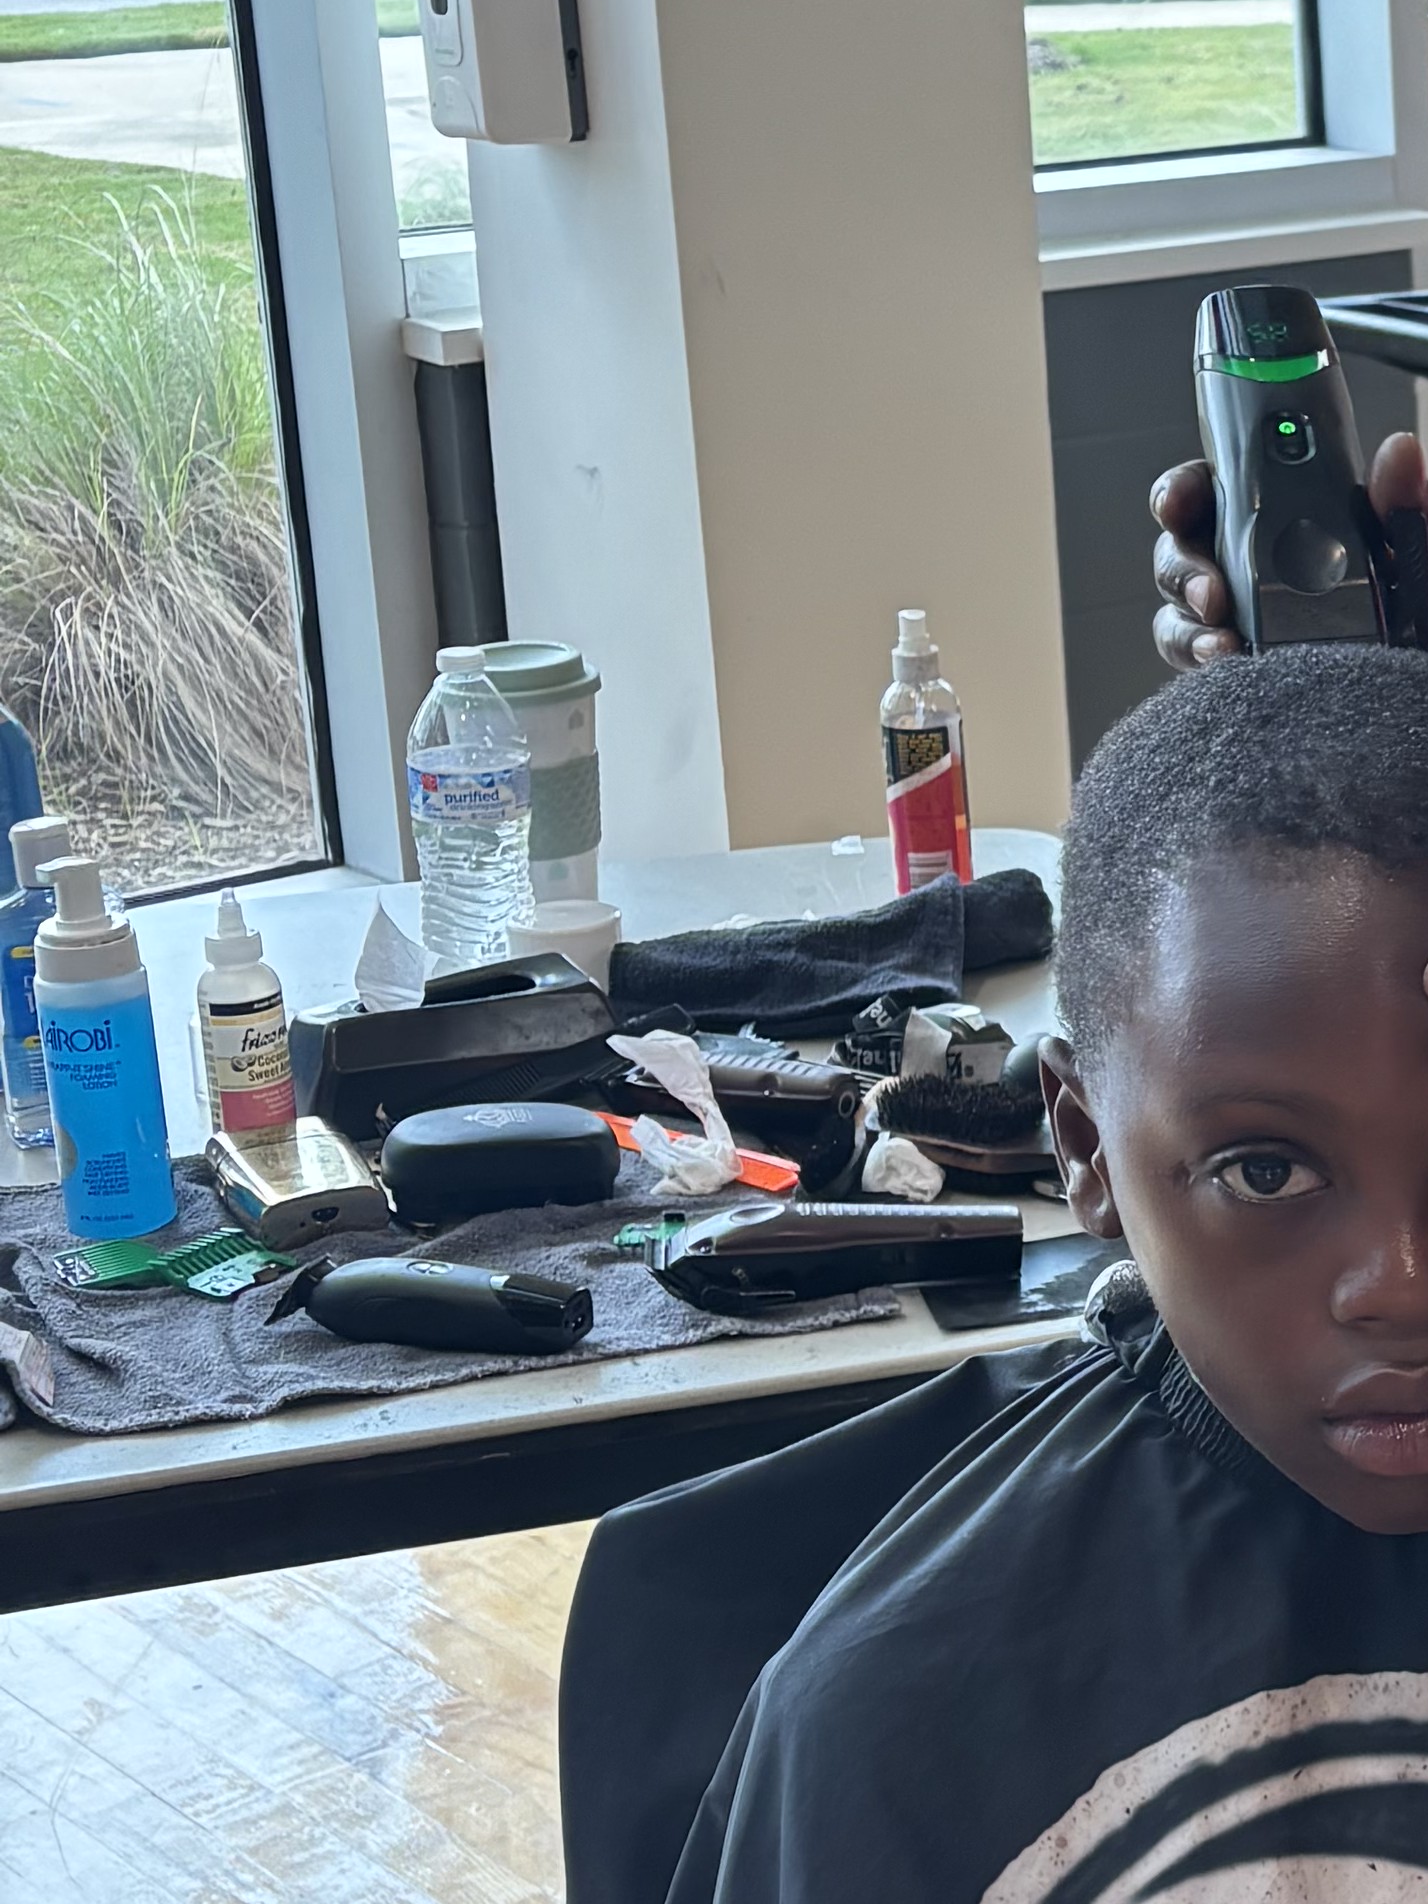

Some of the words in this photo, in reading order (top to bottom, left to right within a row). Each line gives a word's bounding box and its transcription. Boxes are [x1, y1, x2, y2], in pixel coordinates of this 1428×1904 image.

[444, 788, 500, 806] purified
[248, 1063, 280, 1082] Sweet
[82, 1079, 118, 1090] LOTION
